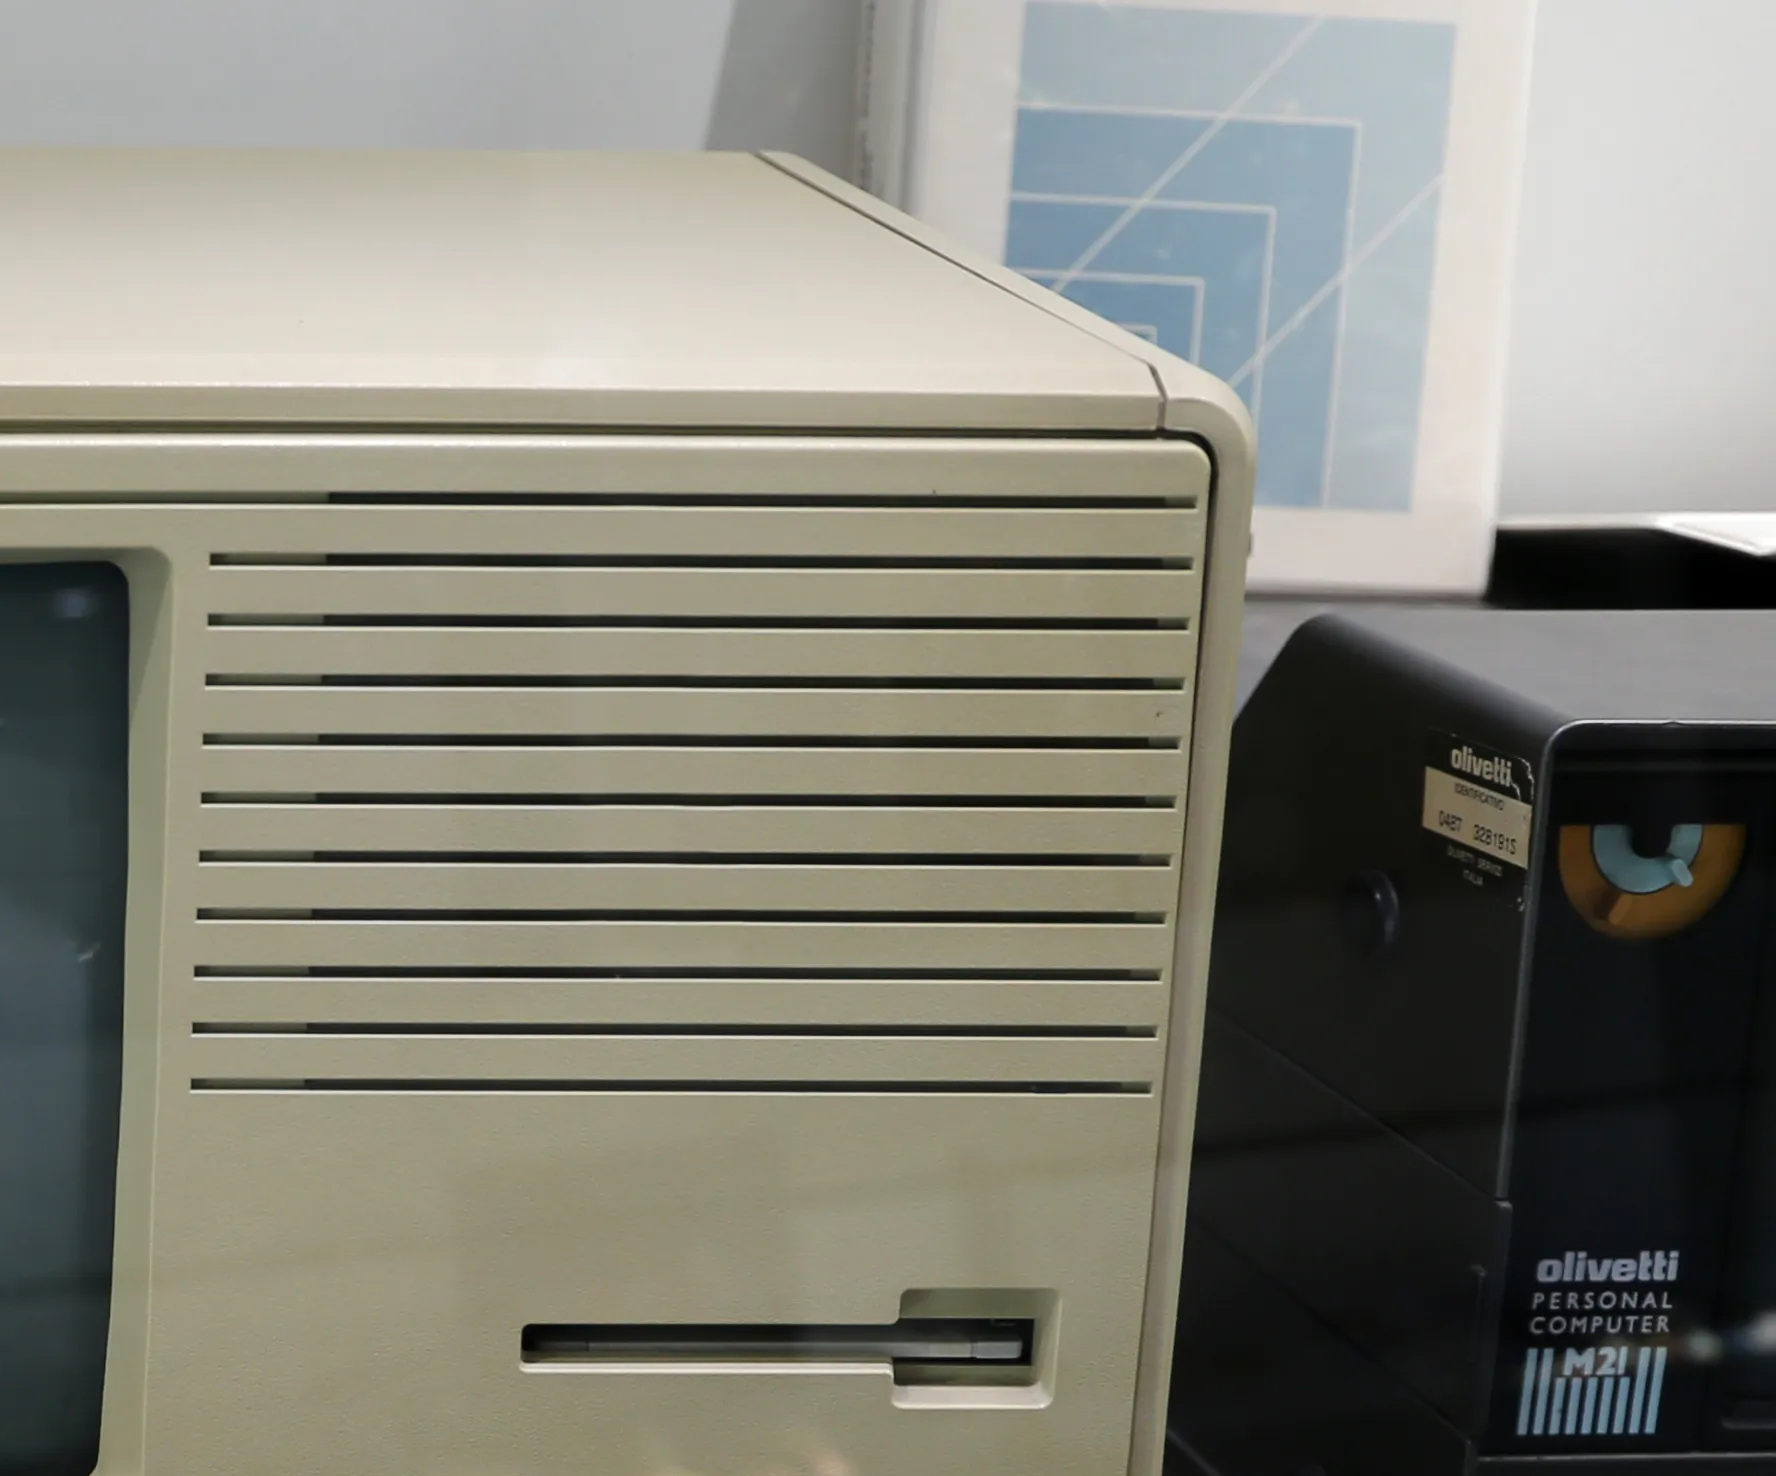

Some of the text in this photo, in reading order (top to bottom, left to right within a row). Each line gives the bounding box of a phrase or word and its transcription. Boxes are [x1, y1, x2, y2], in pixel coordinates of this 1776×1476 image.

[1451, 746, 1512, 786] olivetti
[1536, 1250, 1680, 1283] olivetti
[1532, 1291, 1673, 1309] PERSONAL
[1529, 1315, 1670, 1335] COMPUTER
[1562, 1346, 1629, 1376] M21
